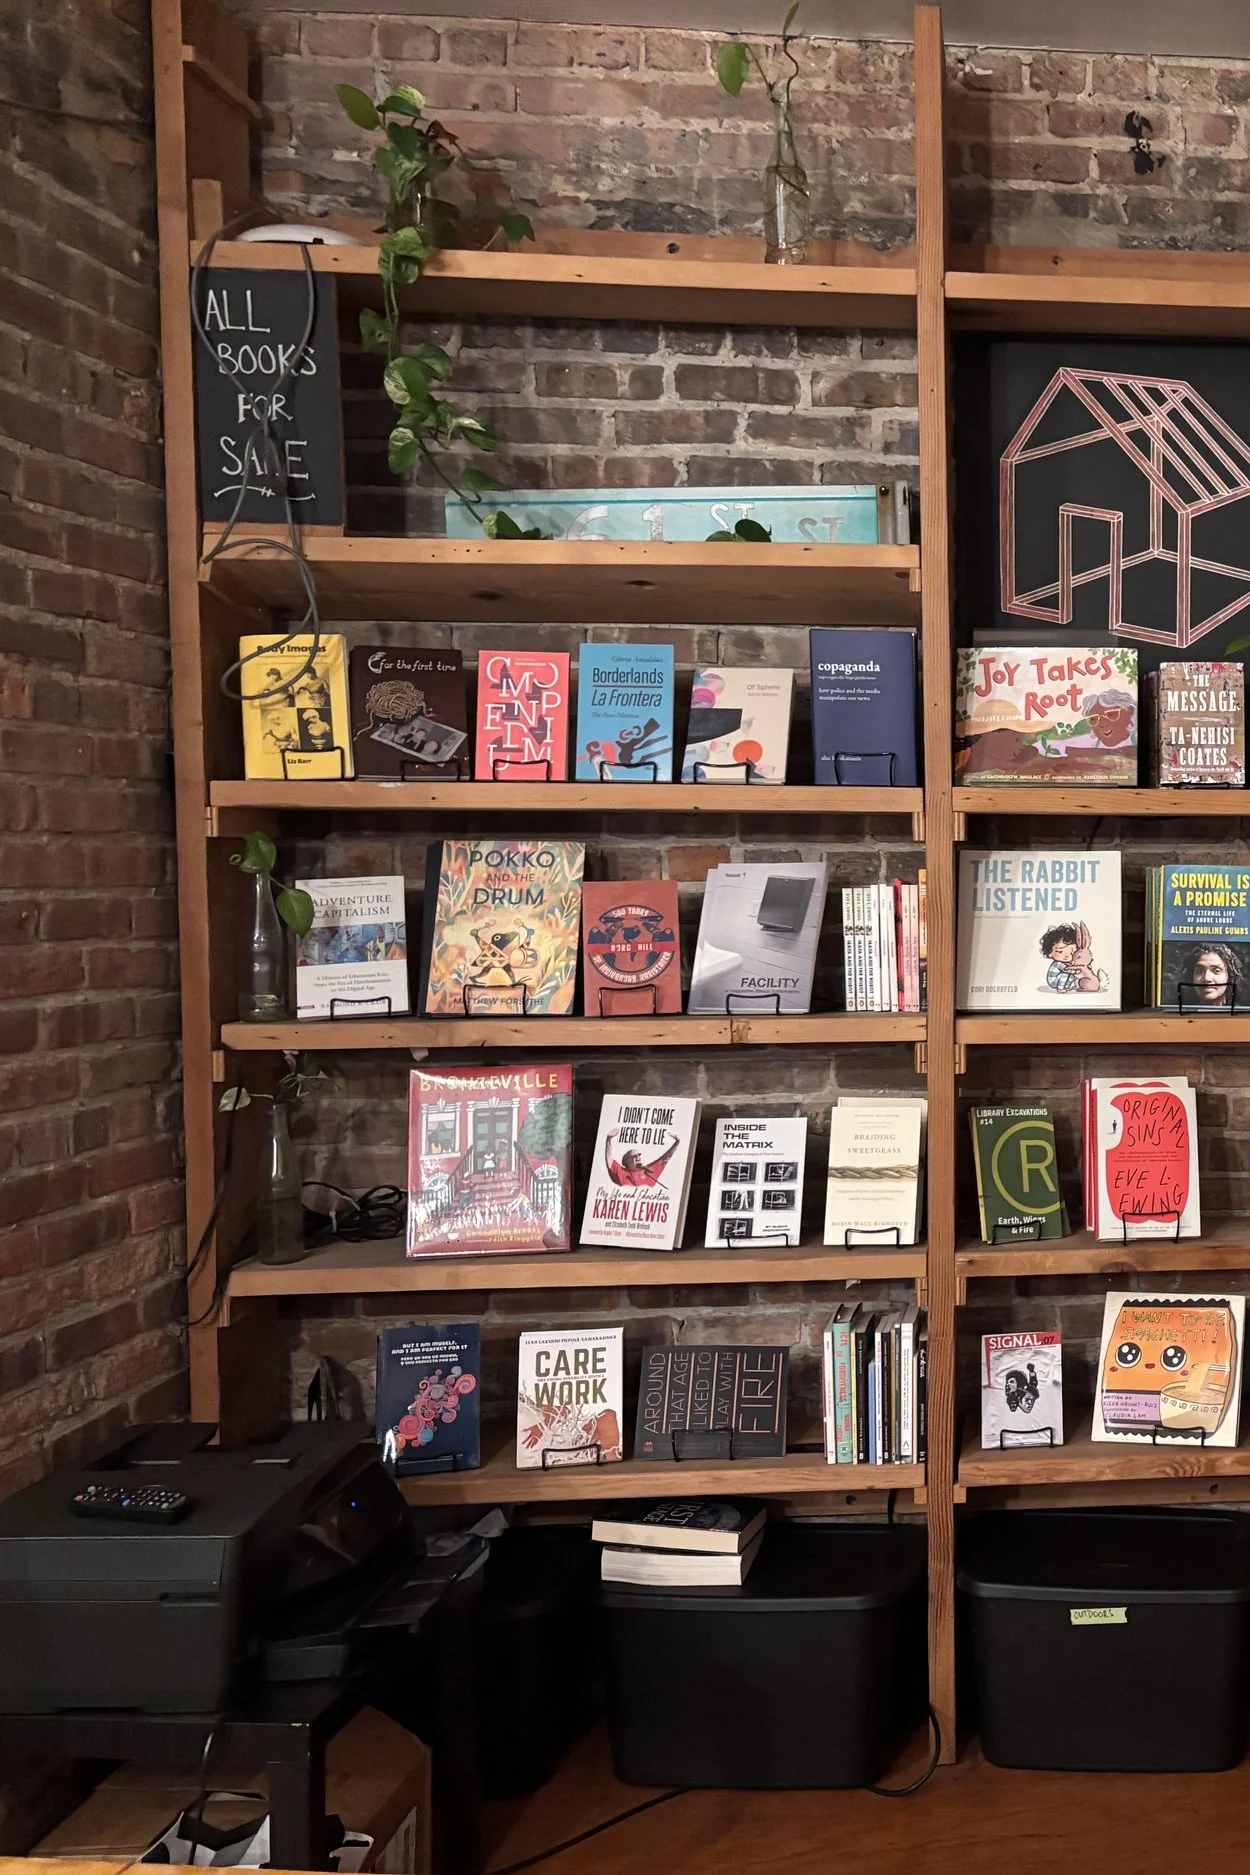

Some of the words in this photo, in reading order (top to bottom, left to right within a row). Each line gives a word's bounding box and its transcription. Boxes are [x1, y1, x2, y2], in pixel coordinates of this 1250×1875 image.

[205, 288, 271, 332] ALL
[219, 343, 317, 376] BOOKS
[592, 667, 664, 684] Borderlands
[818, 661, 880, 675] copaganda
[1193, 674, 1209, 687] THE
[591, 689, 607, 706] La
[609, 689, 662, 707] Frontera
[1167, 690, 1237, 711] MESSAGE
[1169, 727, 1235, 745] TA-NEHISI
[1180, 747, 1227, 766] COATES
[469, 850, 556, 868] POKKO
[486, 873, 510, 883] AND
[513, 873, 535, 883] THE
[971, 860, 1012, 883] THE
[1021, 860, 1100, 883] RABBIT
[1171, 873, 1231, 888] SURVIVAL
[1237, 874, 1250, 889] IS
[312, 894, 392, 907] ADVENTURE
[473, 888, 545, 905] DRUM
[973, 887, 1078, 912] LISTENED
[1173, 891, 1182, 906] A
[1186, 891, 1247, 907] PROMISE
[313, 906, 390, 919] CAPITALISM
[1171, 926, 1194, 934] ALEXIS
[1196, 926, 1223, 935] PAULINE
[1225, 926, 1249, 935] GUMBS
[740, 978, 800, 988] FACILITY
[617, 1106, 622, 1123] I
[623, 1107, 650, 1125] DIDN'T
[650, 1108, 675, 1126] COME
[977, 1108, 1004, 1117] LIBRARY
[1006, 1107, 1047, 1116] EXCAVATIONS
[619, 1127, 640, 1145] HERE
[641, 1127, 653, 1145] TO
[654, 1128, 666, 1146] LIE
[723, 1132, 749, 1140] THE
[1127, 1122, 1165, 1148] SINS
[722, 1141, 774, 1149] MATRIX
[1115, 1169, 1150, 1190] EVE
[637, 1188, 670, 1202] Education
[1118, 1184, 1184, 1217] EWING
[593, 1199, 630, 1220] KAREN
[632, 1201, 669, 1223] LEWIS
[998, 1216, 1022, 1225] Earth,
[1122, 1310, 1127, 1324] I
[1132, 1311, 1174, 1324] WANT
[989, 1334, 1041, 1349] SIGNAL
[535, 1347, 607, 1377] CARE
[673, 1351, 690, 1389] AGE
[698, 1351, 712, 1376] TO
[718, 1352, 734, 1390] WITH
[534, 1378, 607, 1408] WORK
[644, 1353, 666, 1434] AROUND
[738, 1353, 777, 1434] FIRE
[692, 1379, 710, 1426] LIKED
[668, 1390, 687, 1435] THAT
[1073, 1609, 1114, 1620] OUTDOORS
